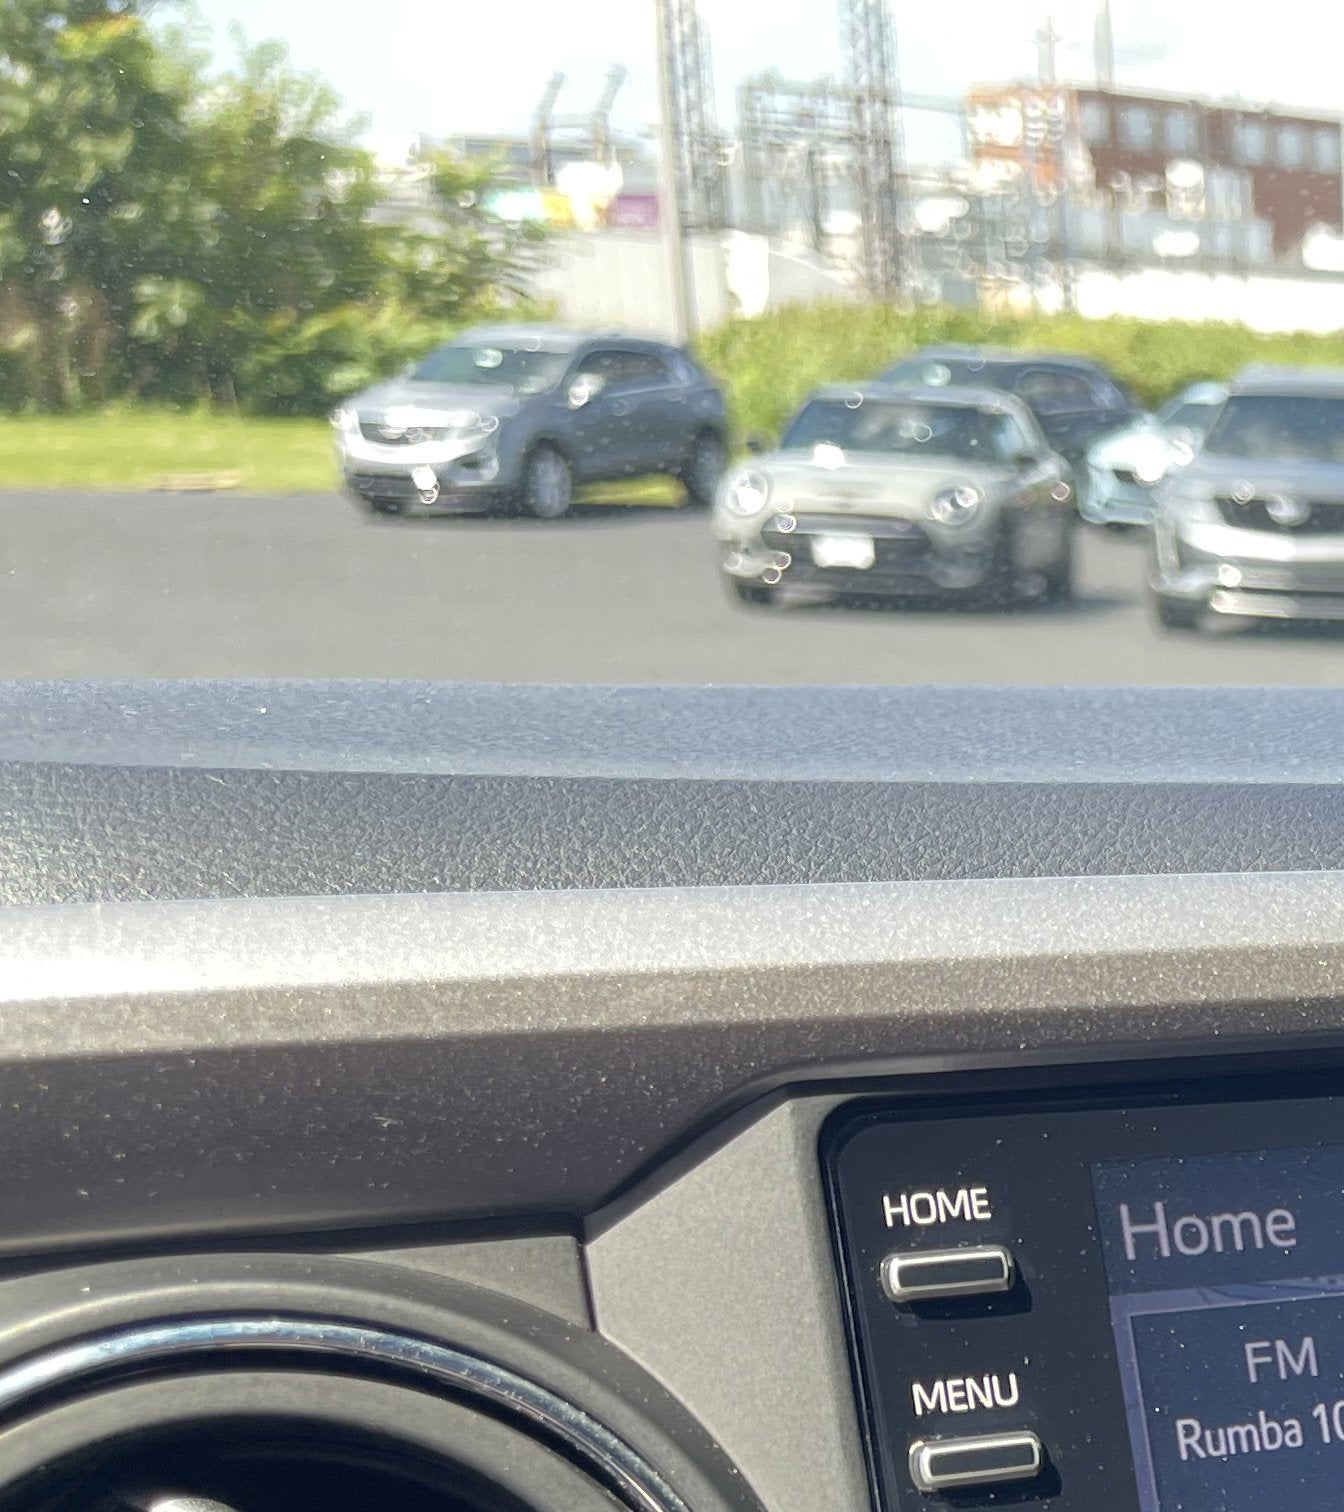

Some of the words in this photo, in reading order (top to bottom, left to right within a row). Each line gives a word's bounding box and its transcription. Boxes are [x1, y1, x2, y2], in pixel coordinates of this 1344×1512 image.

[882, 1187, 992, 1227] HOME
[1119, 1201, 1298, 1261] Home
[1244, 1336, 1320, 1384] FM
[911, 1373, 1020, 1416] MENU
[1176, 1411, 1304, 1461] Rumba
